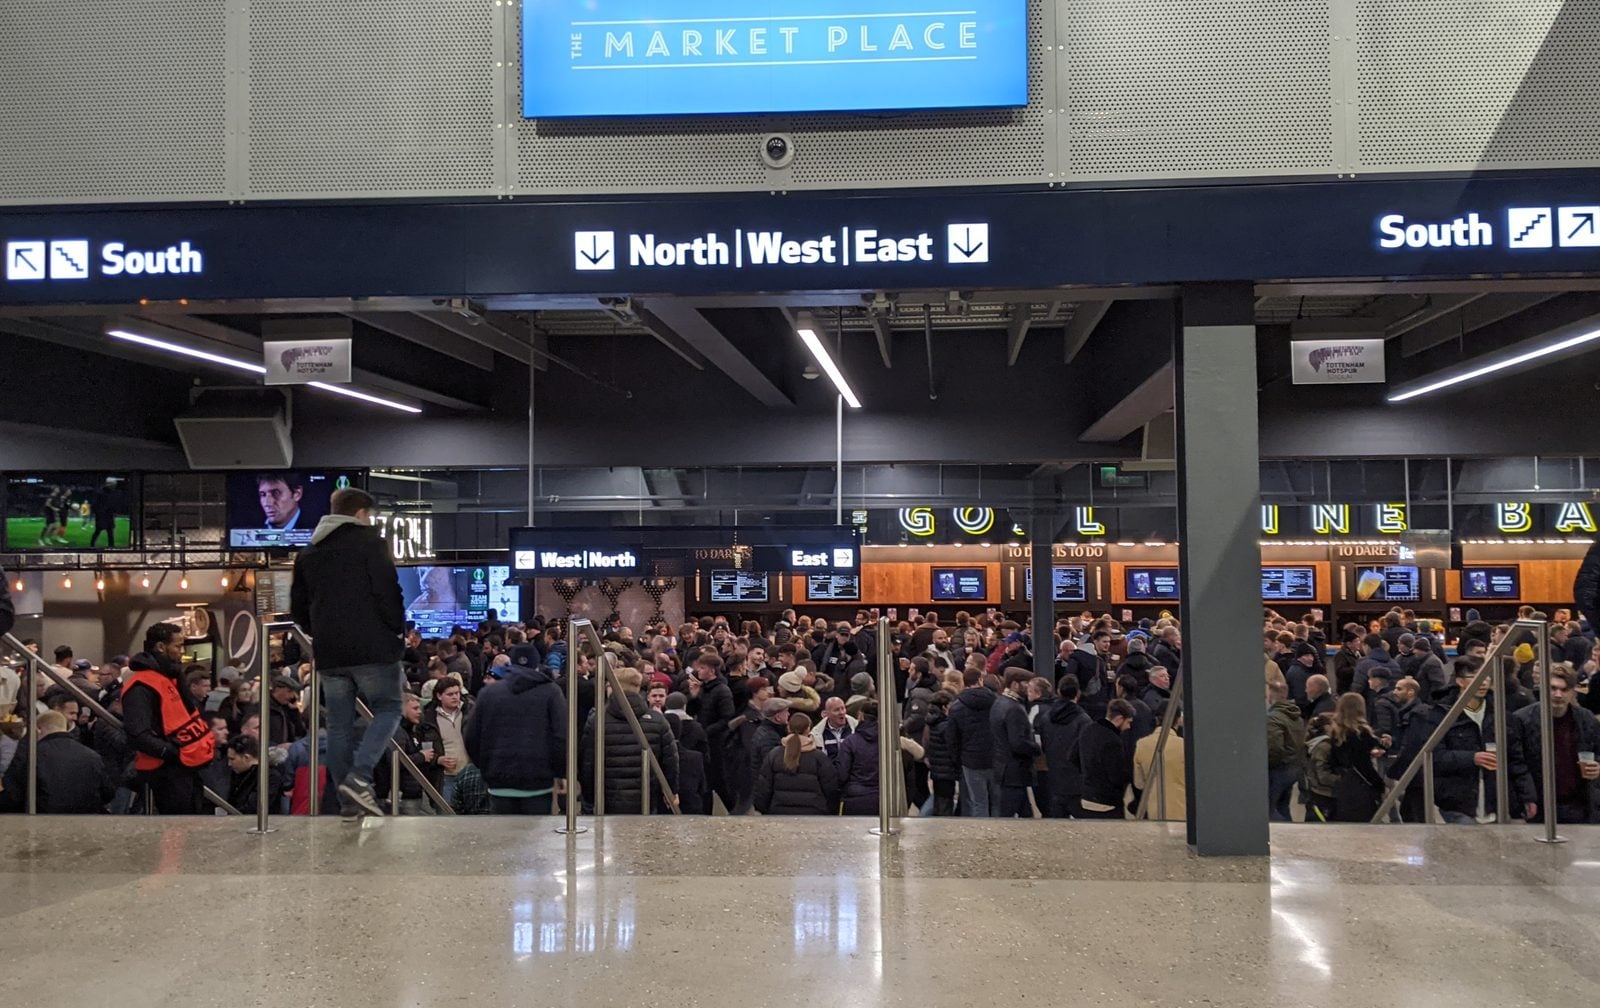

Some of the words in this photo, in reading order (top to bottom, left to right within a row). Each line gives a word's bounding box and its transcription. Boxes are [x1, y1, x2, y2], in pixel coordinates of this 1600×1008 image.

[570, 31, 584, 60] THE
[603, 26, 800, 58] MARKET
[826, 20, 978, 53] PLACE
[1379, 211, 1493, 249] South
[101, 240, 203, 275] South
[629, 233, 729, 266] North
[746, 231, 836, 264] West
[855, 228, 933, 262] East
[540, 551, 583, 569] West
[588, 550, 636, 569] North
[791, 550, 829, 567] East
[1086, 547, 1103, 556] DO
[1355, 546, 1387, 556] DARE
